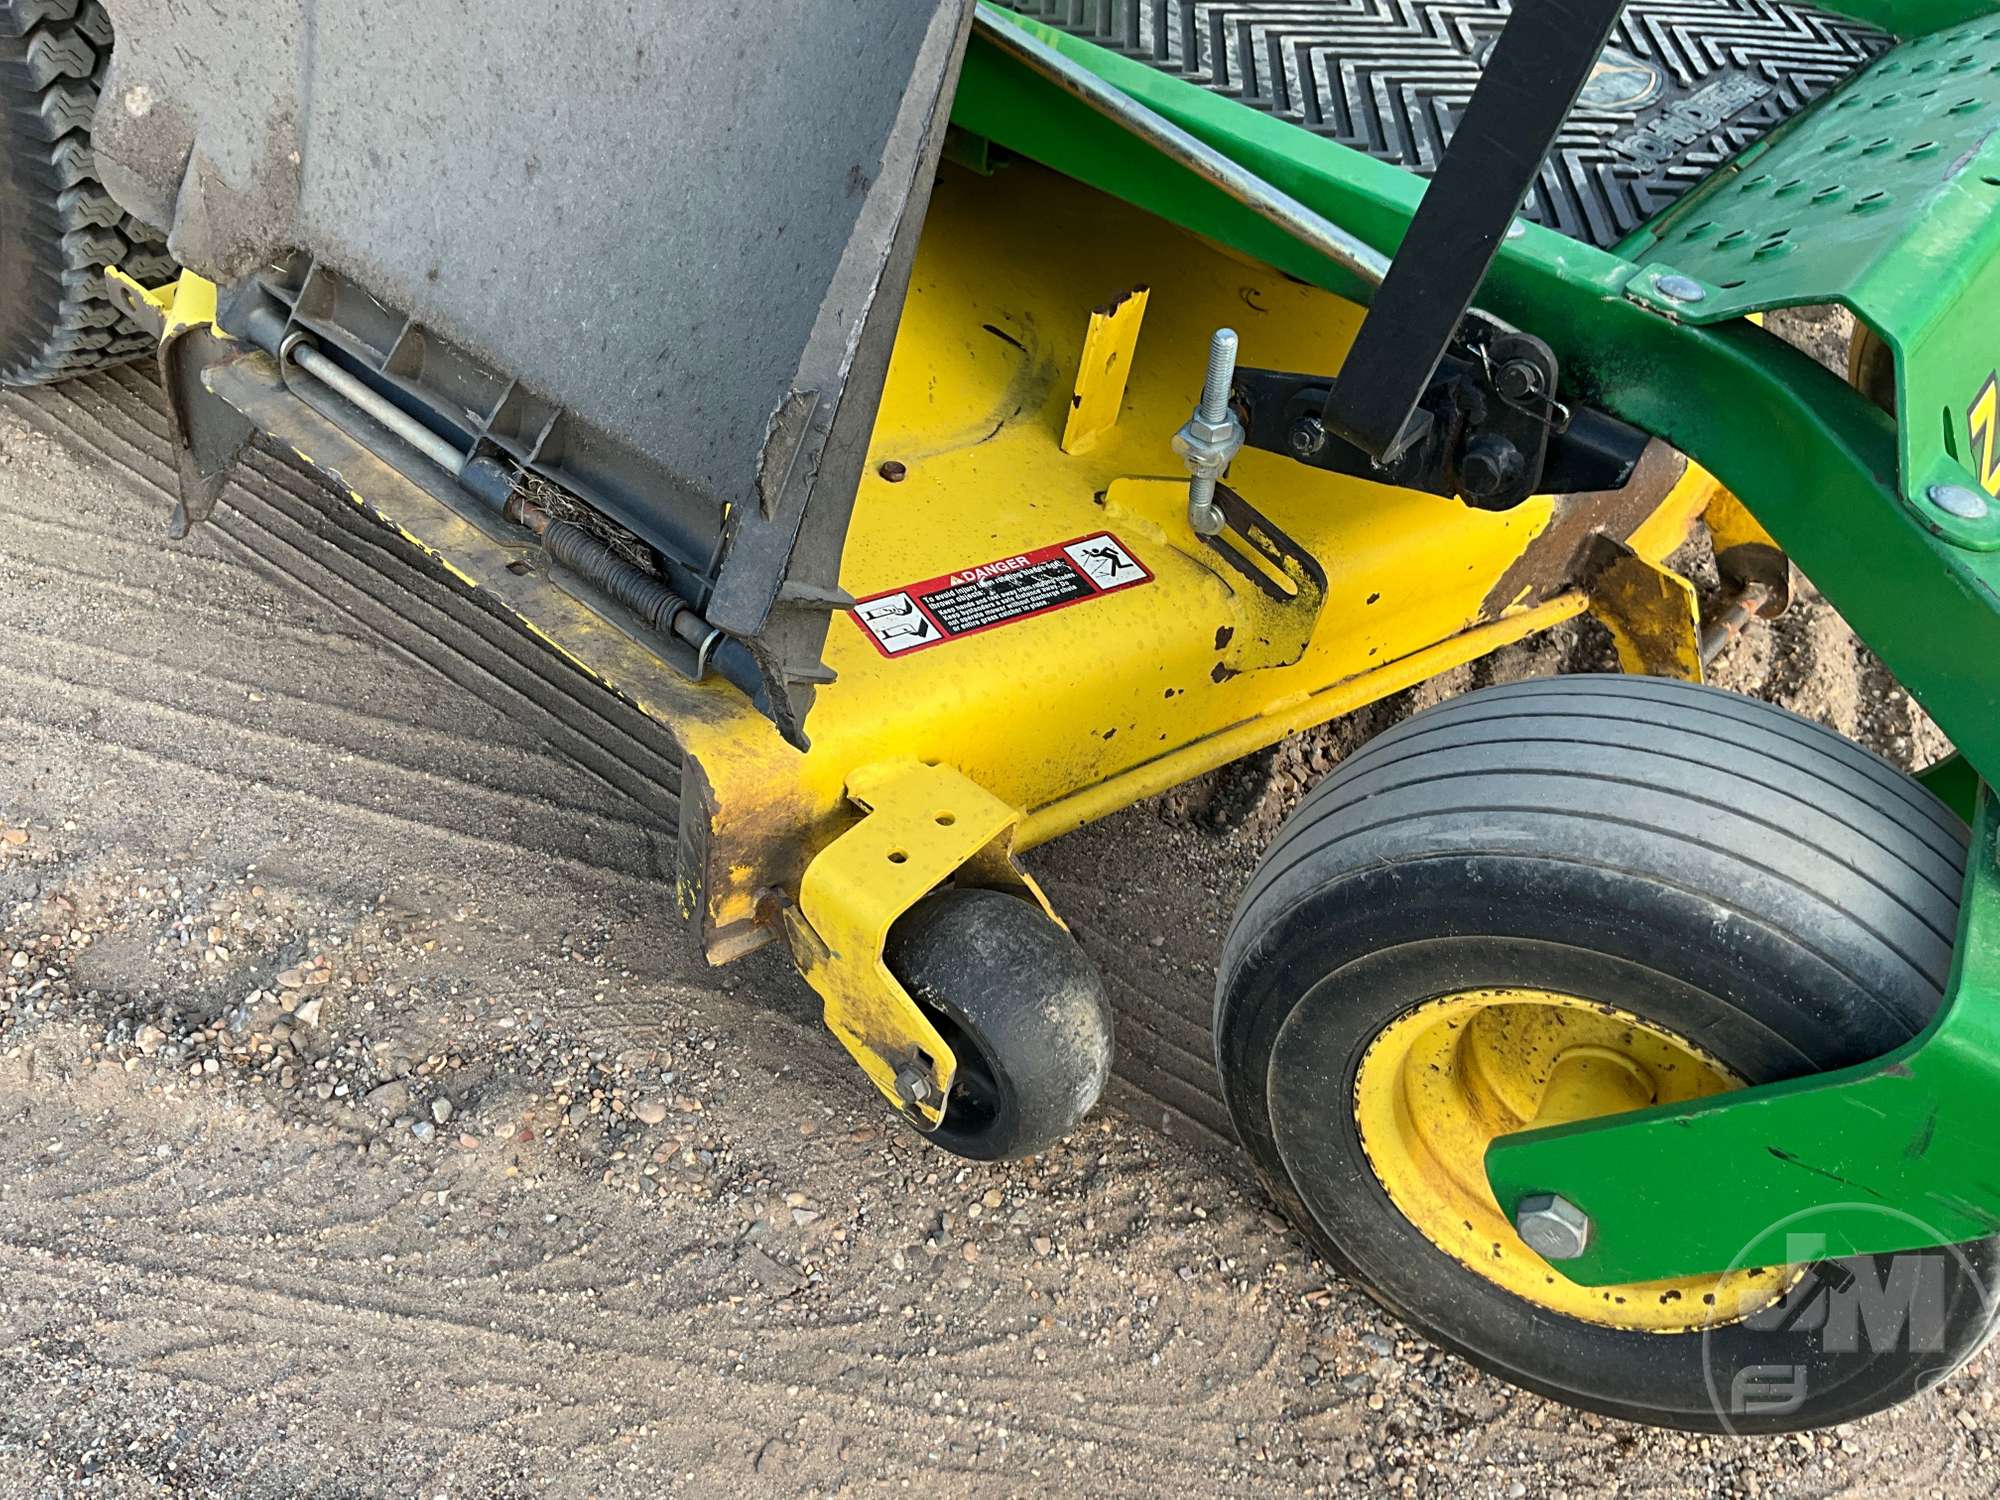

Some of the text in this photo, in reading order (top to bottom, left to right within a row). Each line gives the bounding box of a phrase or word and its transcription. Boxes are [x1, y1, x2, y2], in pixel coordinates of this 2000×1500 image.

[961, 556, 1030, 582] DANGER
[927, 598, 956, 609] thrown
[933, 590, 956, 600] avoid
[954, 584, 978, 595] injury
[937, 606, 956, 615] Keep
[954, 601, 975, 610] hands
[999, 589, 1018, 597] away
[942, 612, 961, 620] Keep
[959, 602, 996, 616] bystanders
[1014, 588, 1041, 599] distance
[1040, 583, 1060, 592] away.
[958, 612, 984, 623] operate
[983, 606, 1006, 614] mower
[1005, 598, 1030, 608] without
[1029, 589, 1061, 602] discharge
[1058, 584, 1077, 592] chute
[960, 620, 980, 628] entire
[980, 614, 999, 623] grass
[997, 607, 1022, 617] catcher
[1028, 599, 1050, 609] place.
